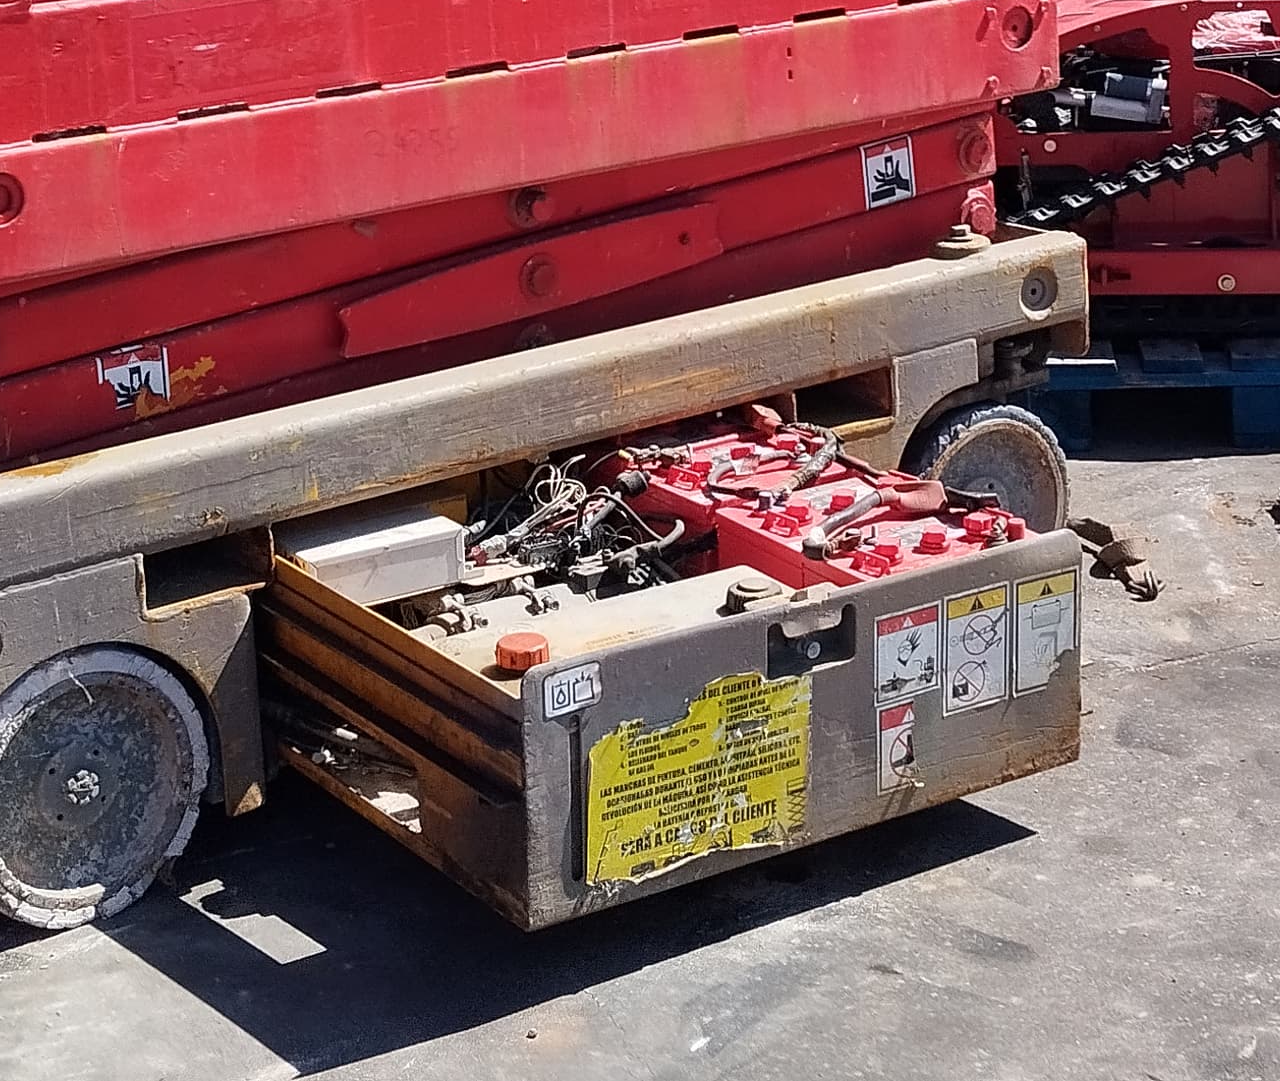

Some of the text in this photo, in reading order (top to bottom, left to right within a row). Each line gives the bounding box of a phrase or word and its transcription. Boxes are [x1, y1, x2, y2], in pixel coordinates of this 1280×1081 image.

[708, 686, 719, 697] DEL
[722, 679, 749, 695] CLIENTE
[600, 787, 611, 797] LAS
[613, 778, 645, 794] MANCHAS
[647, 775, 655, 784] DE
[655, 831, 662, 847] A
[733, 799, 776, 824] CLIENTE
